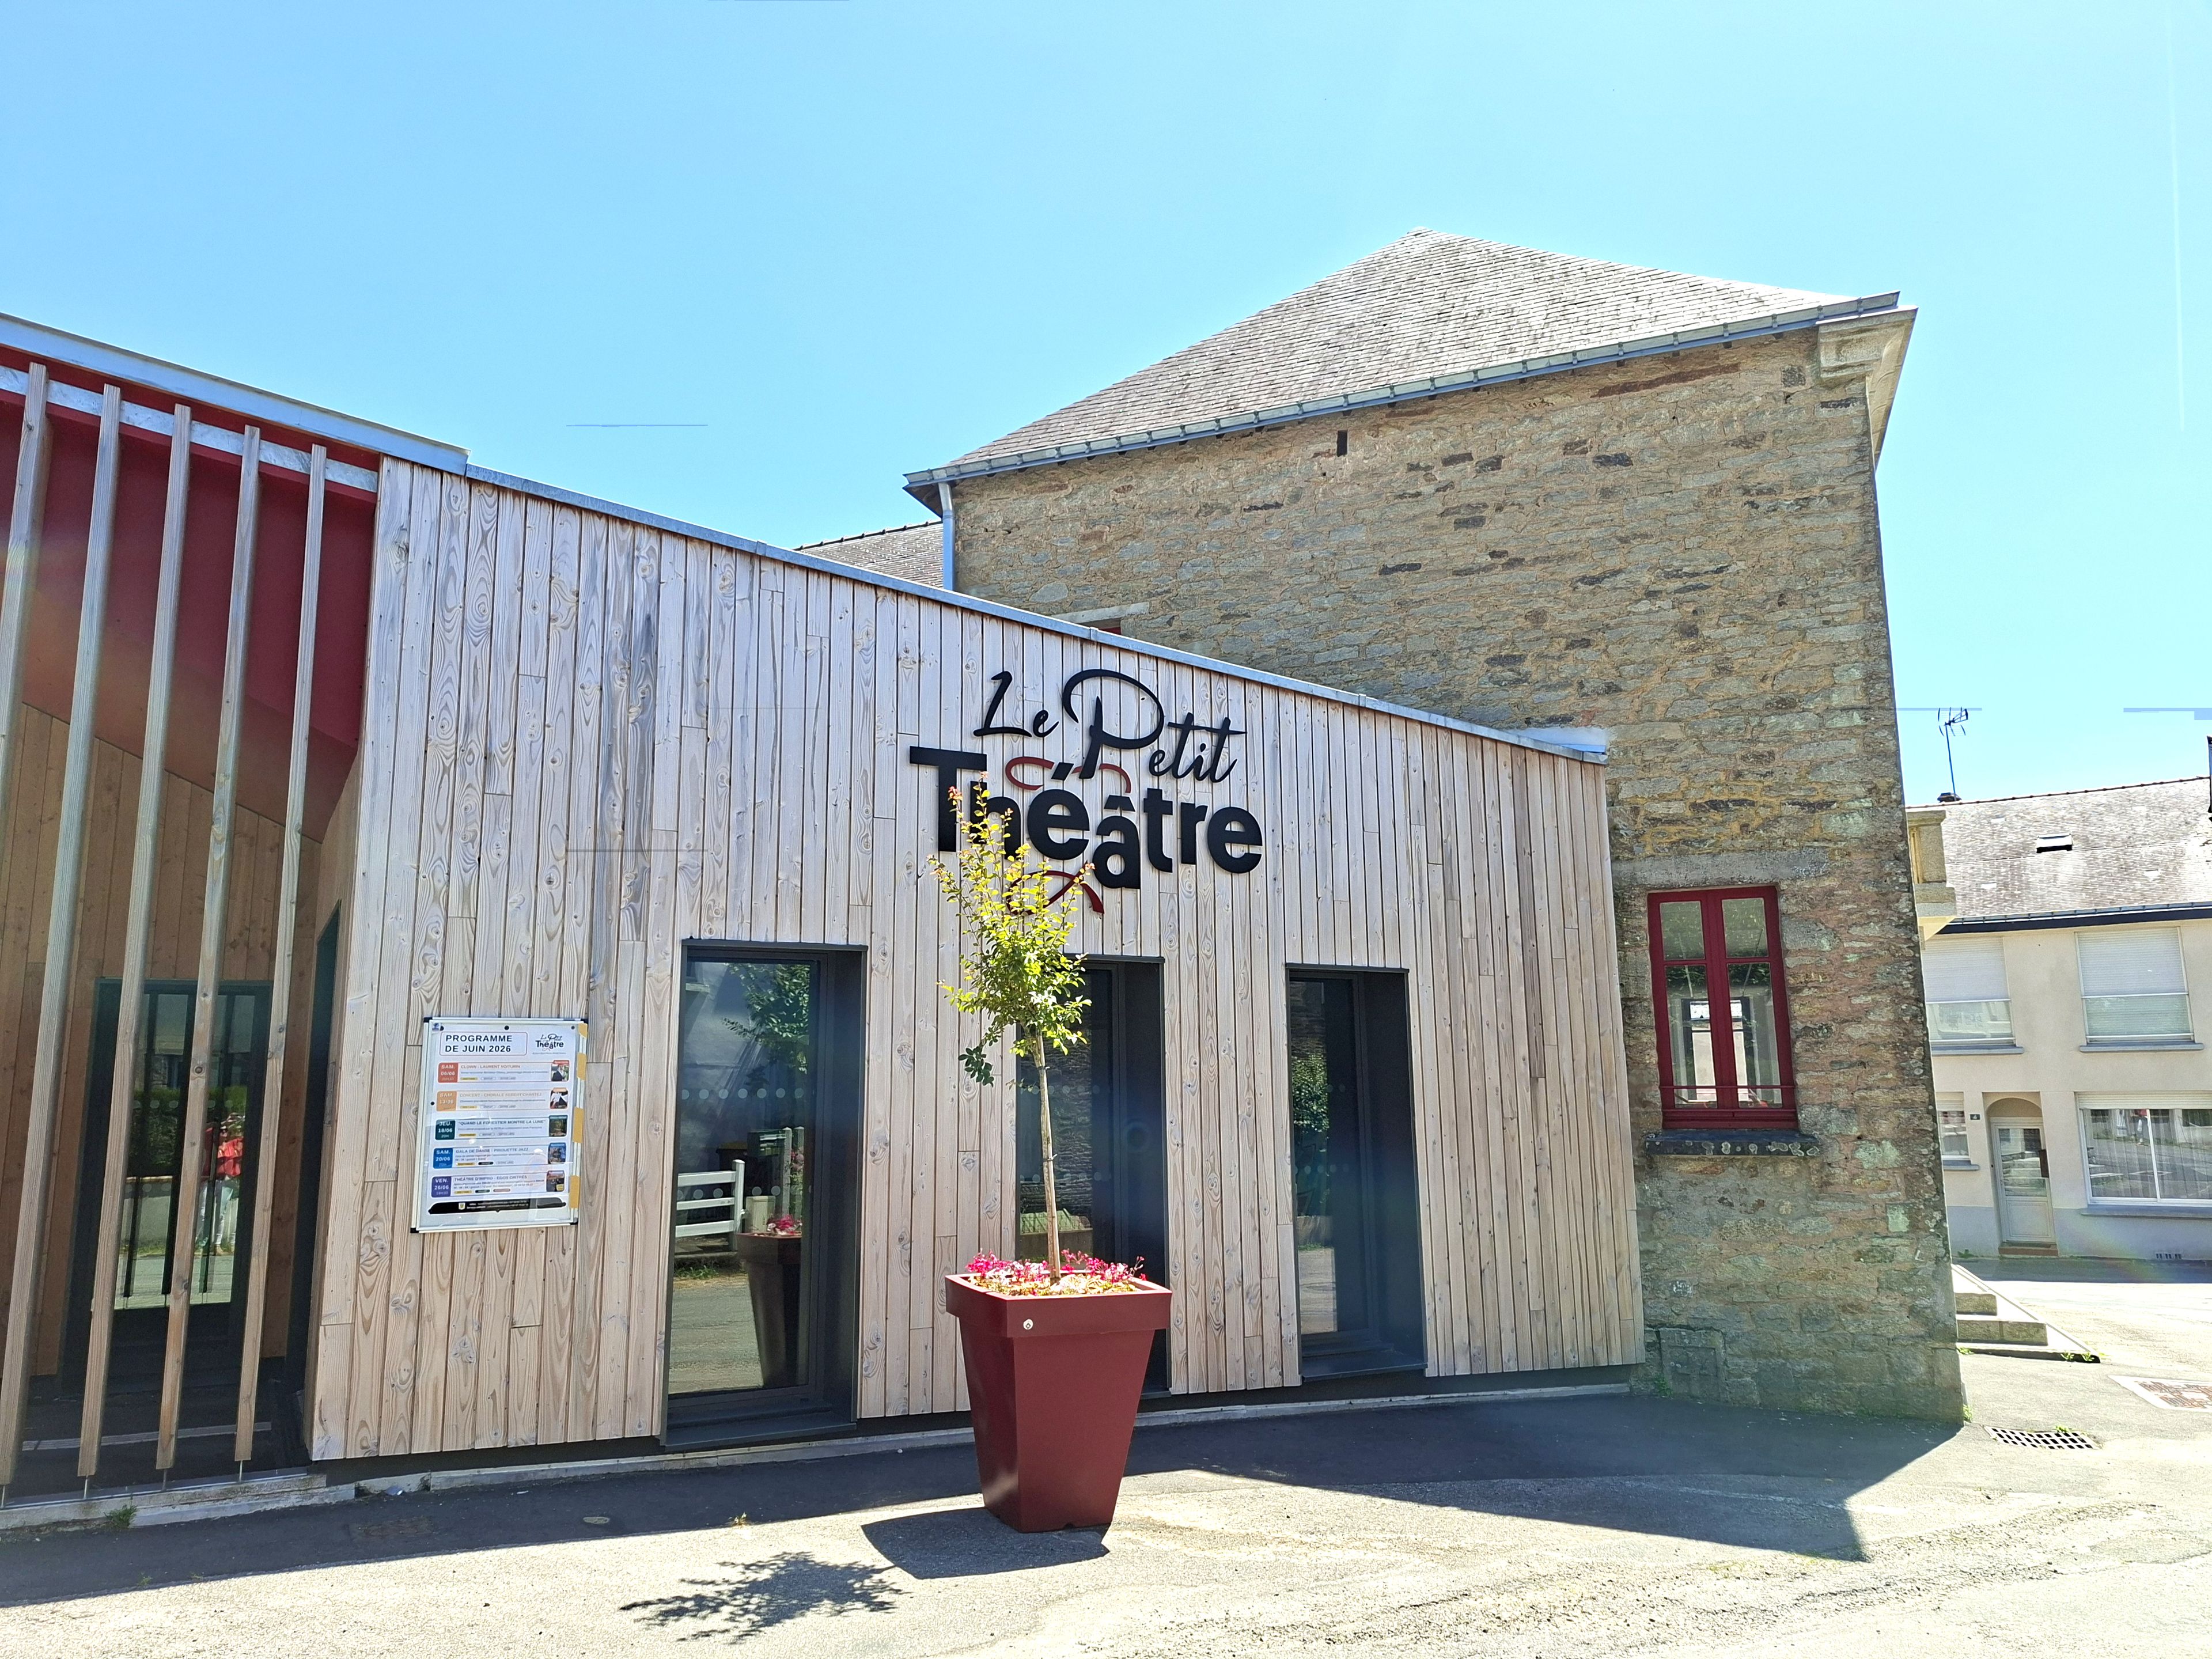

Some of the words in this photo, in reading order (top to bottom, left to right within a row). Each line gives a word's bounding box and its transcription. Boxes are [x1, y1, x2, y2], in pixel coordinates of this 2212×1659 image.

[973, 671, 1059, 738] Le
[1062, 669, 1247, 783] Petit
[910, 745, 1263, 889] Théâtre
[535, 1040, 564, 1049] Théâtre
